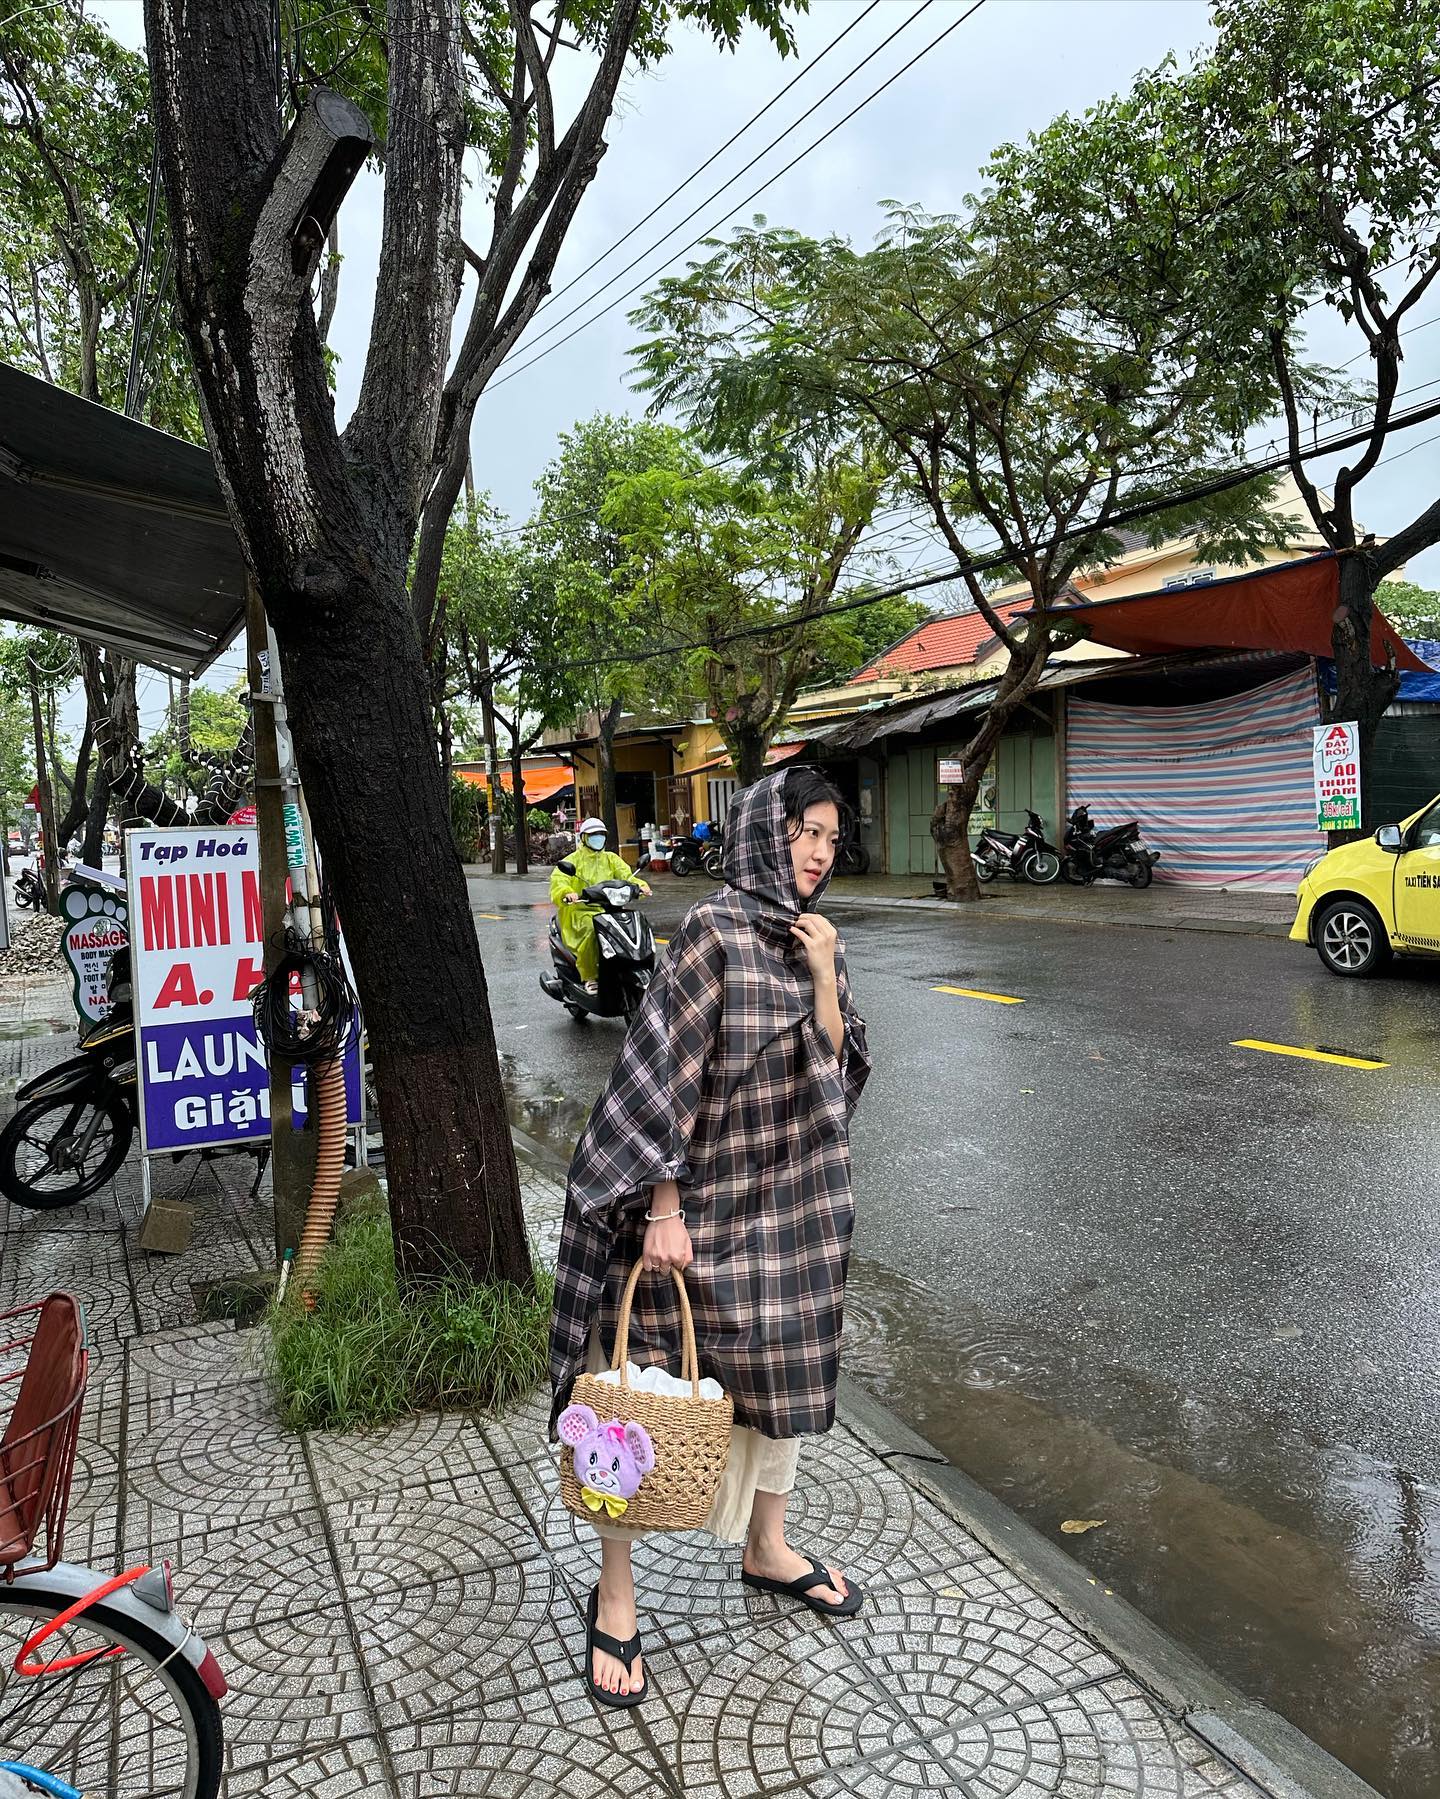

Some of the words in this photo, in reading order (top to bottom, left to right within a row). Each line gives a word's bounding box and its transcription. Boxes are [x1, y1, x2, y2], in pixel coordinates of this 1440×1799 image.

[140, 842, 188, 866] Tạp
[195, 837, 248, 858] Hoá
[139, 871, 231, 951] MINI
[69, 930, 126, 950] MASSAGE
[81, 951, 97, 960] BODY
[98, 948, 119, 958] MASS
[83, 974, 99, 983] FOOT
[152, 963, 214, 1010] A.
[89, 995, 112, 1006] NAI
[146, 1030, 268, 1084] LAUN
[174, 1088, 271, 1131] Giặt
